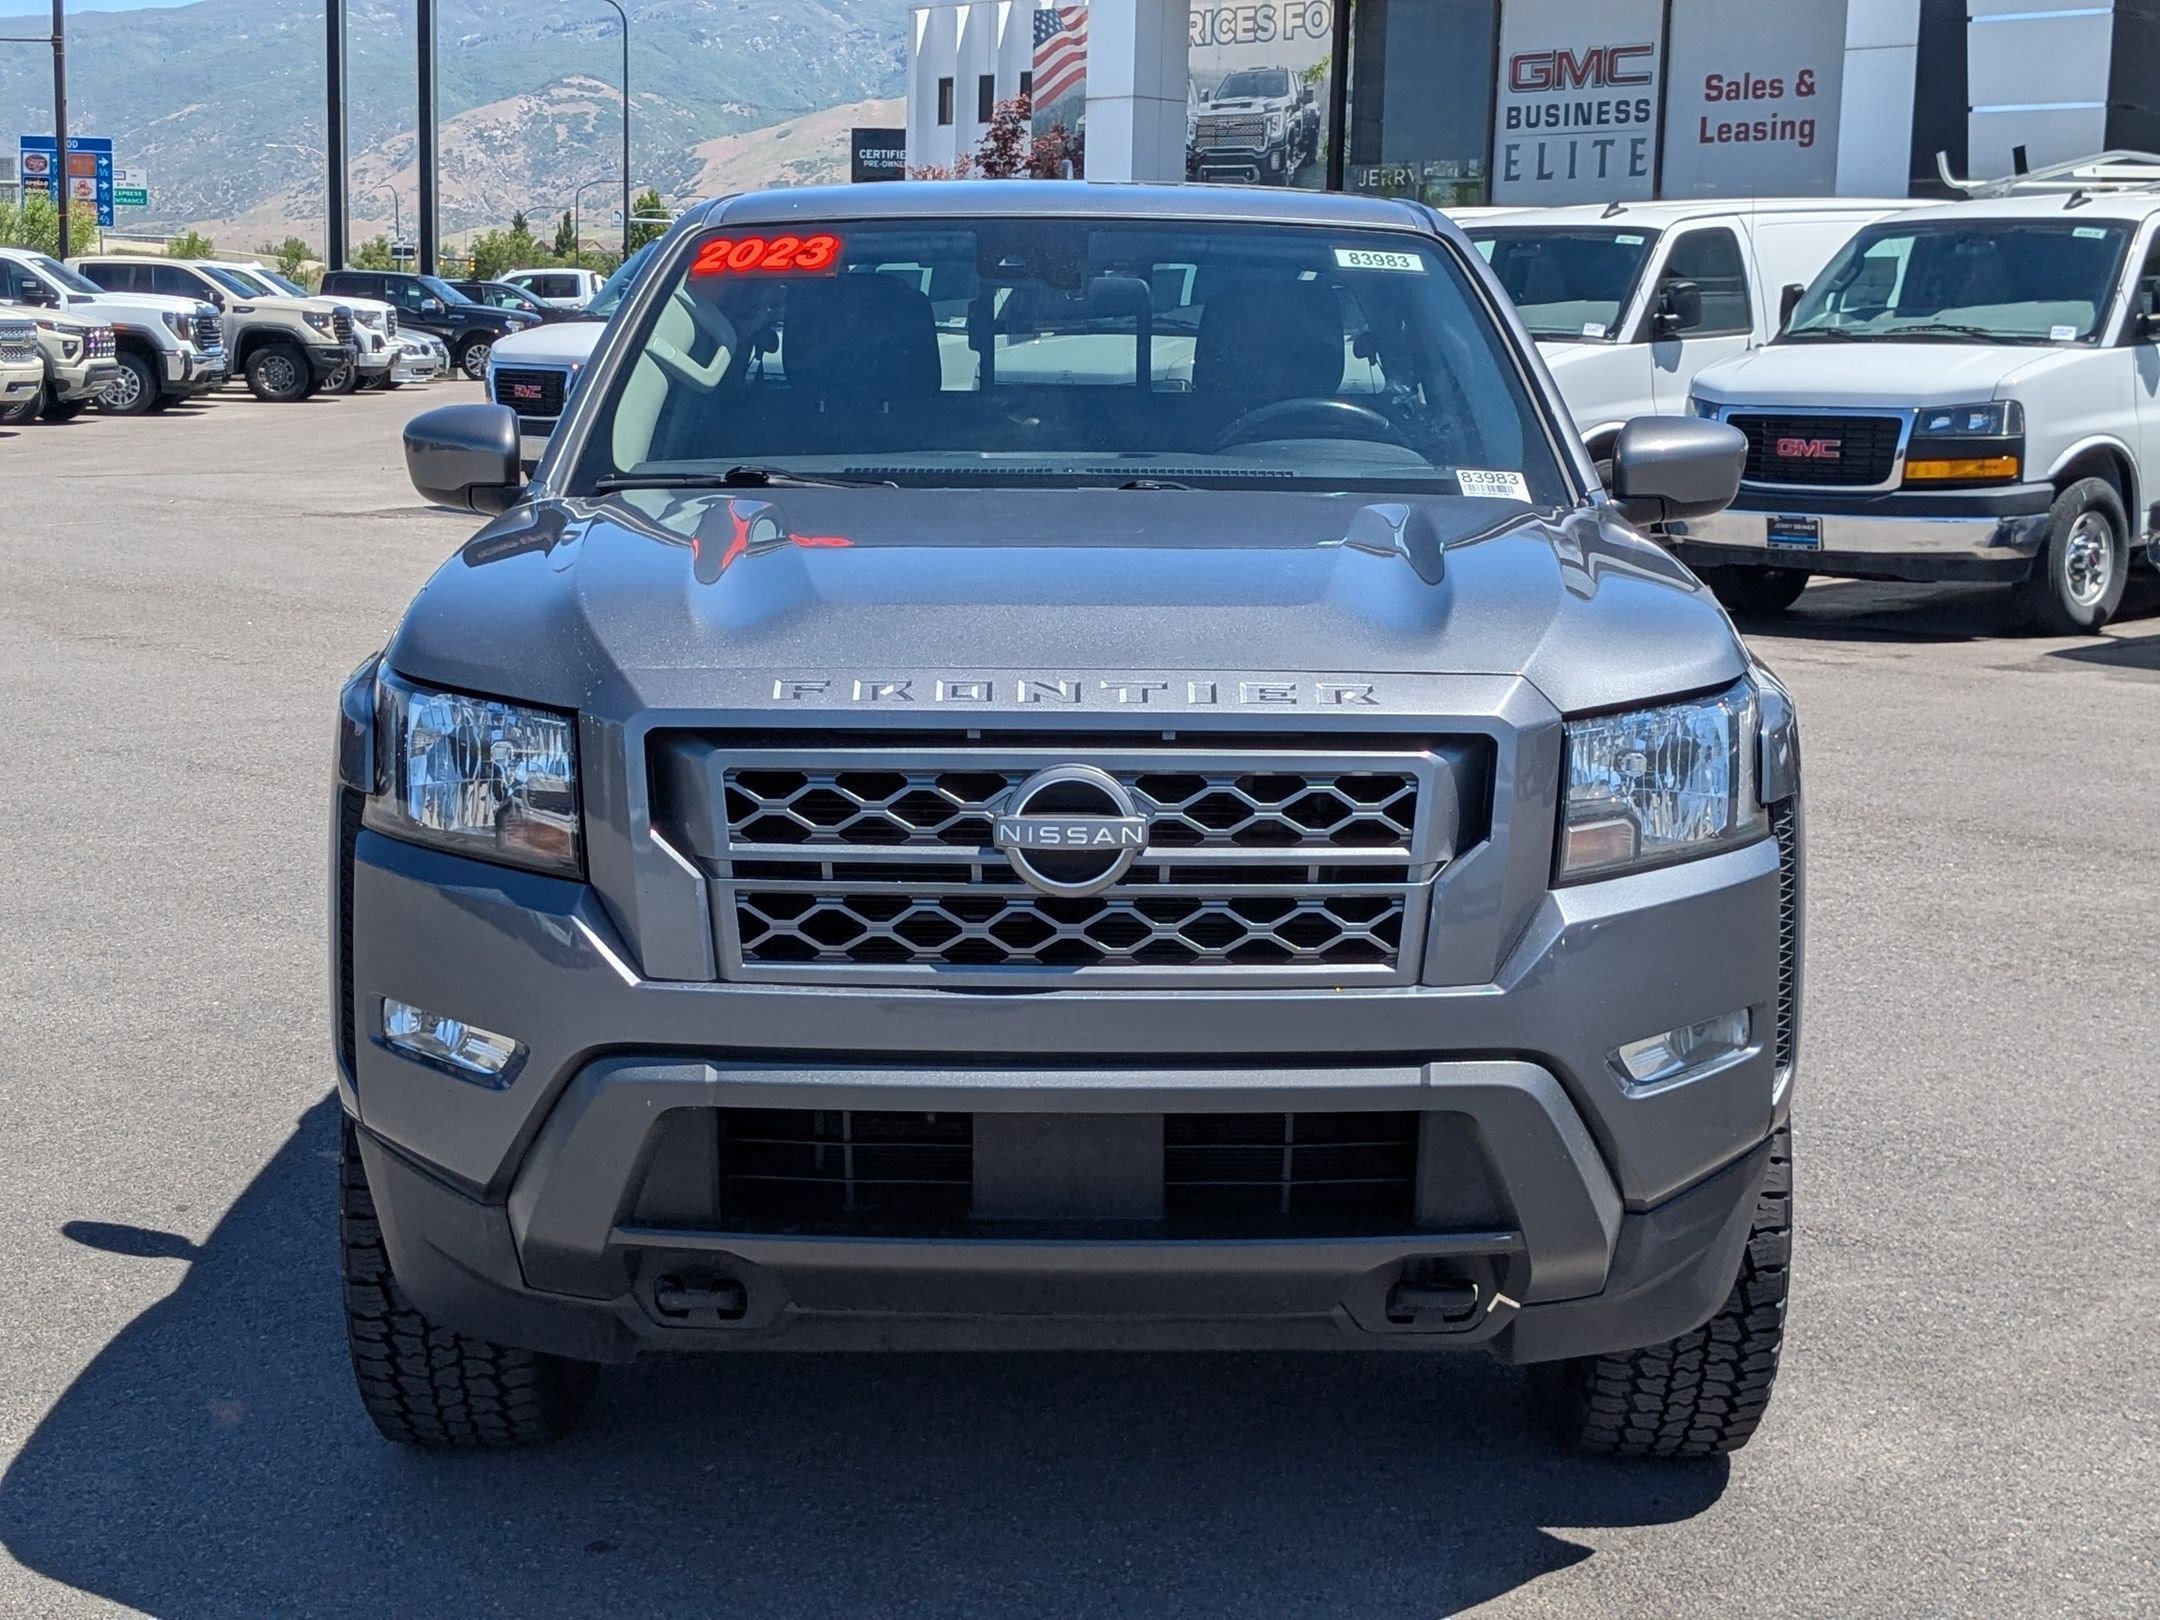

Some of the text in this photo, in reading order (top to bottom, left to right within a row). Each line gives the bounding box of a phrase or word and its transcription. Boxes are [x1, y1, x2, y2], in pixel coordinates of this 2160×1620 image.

[1190, 0, 1334, 46] RICES FO
[1509, 43, 1654, 92] GMC
[1704, 69, 1816, 102] Sales &
[1506, 99, 1650, 129] BUSINESS
[1699, 112, 1816, 148] Leasing
[859, 149, 907, 160] CERTIFIE
[863, 160, 906, 168] PRE-OWNE
[1503, 138, 1647, 182] ELITE
[692, 235, 841, 273] 2023
[1348, 252, 1410, 268] 83983
[1776, 438, 1841, 458] GMC
[1461, 471, 1519, 485] 83983
[773, 679, 1380, 706] FRONTIER
[1000, 824, 1143, 845] NISSAN
